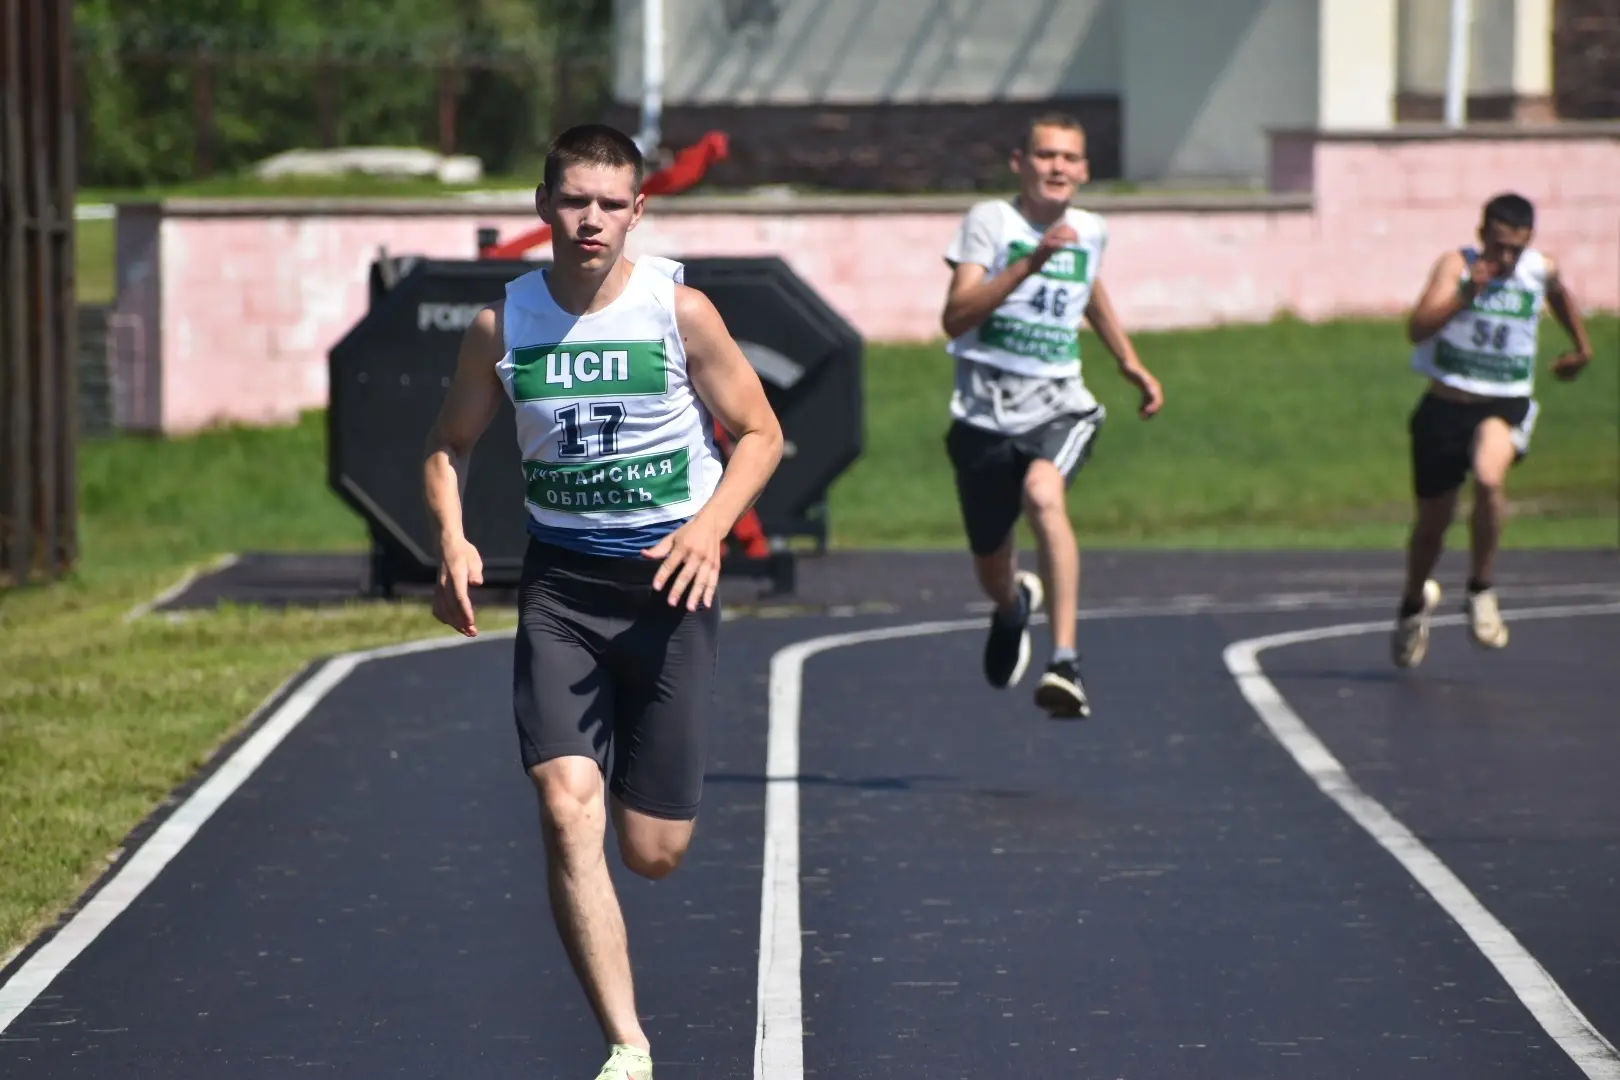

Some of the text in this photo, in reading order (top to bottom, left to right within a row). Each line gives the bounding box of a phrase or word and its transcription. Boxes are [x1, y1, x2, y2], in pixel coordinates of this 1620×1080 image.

[1030, 285, 1068, 317] 46
[545, 350, 628, 389] ЦСП
[554, 401, 627, 458] 17
[546, 487, 653, 506] ОБЛАСТЬ
